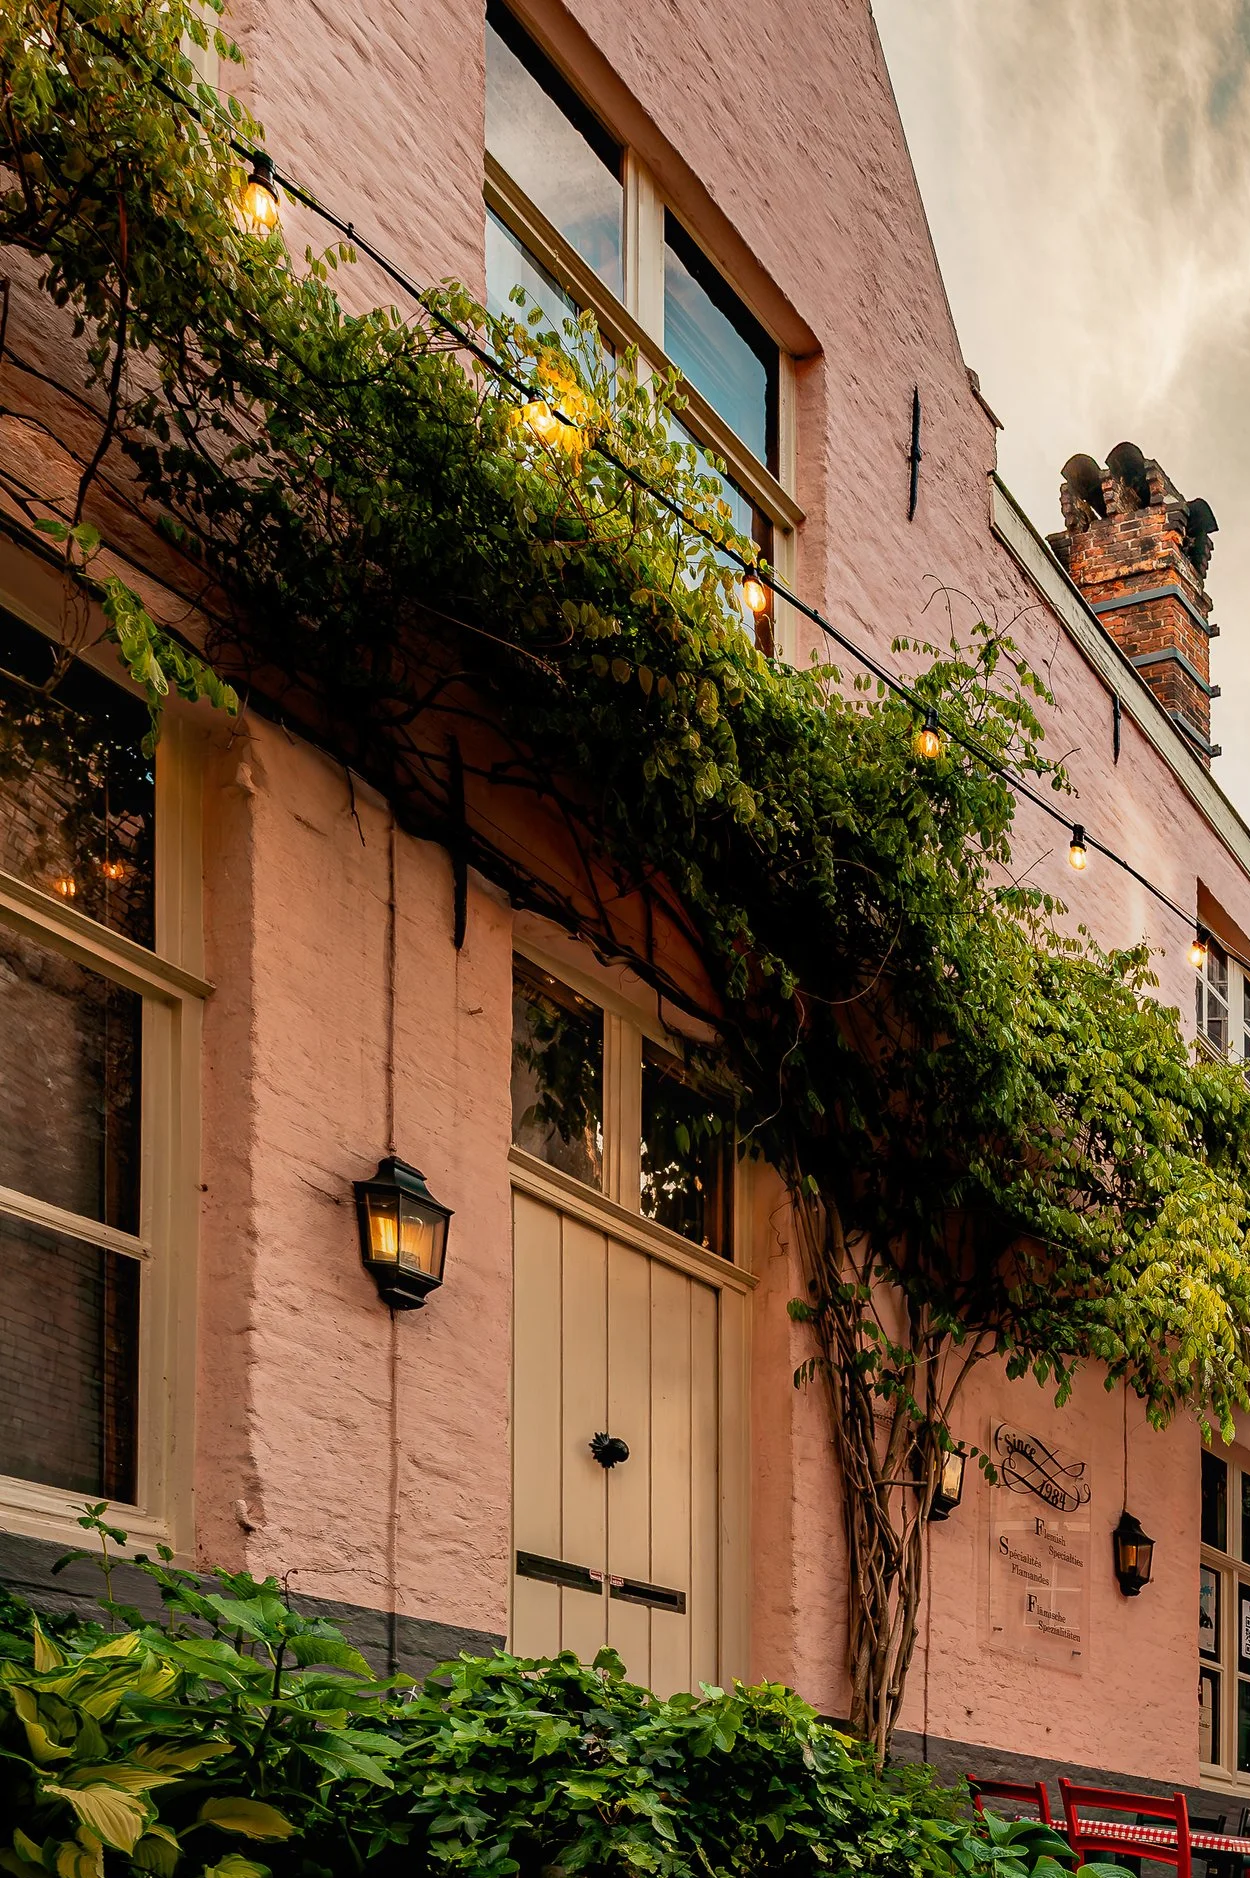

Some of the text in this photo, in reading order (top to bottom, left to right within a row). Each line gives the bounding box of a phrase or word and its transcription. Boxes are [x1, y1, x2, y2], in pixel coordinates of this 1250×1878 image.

[1039, 1479, 1066, 1510] 1984
[1034, 1517, 1066, 1546] Flemish
[999, 1536, 1042, 1568] Spécialités
[1048, 1546, 1083, 1567] Specialties
[1011, 1563, 1050, 1586] Flamandes
[1027, 1594, 1066, 1623] Flämische
[1038, 1621, 1081, 1642] Spezialitäten
